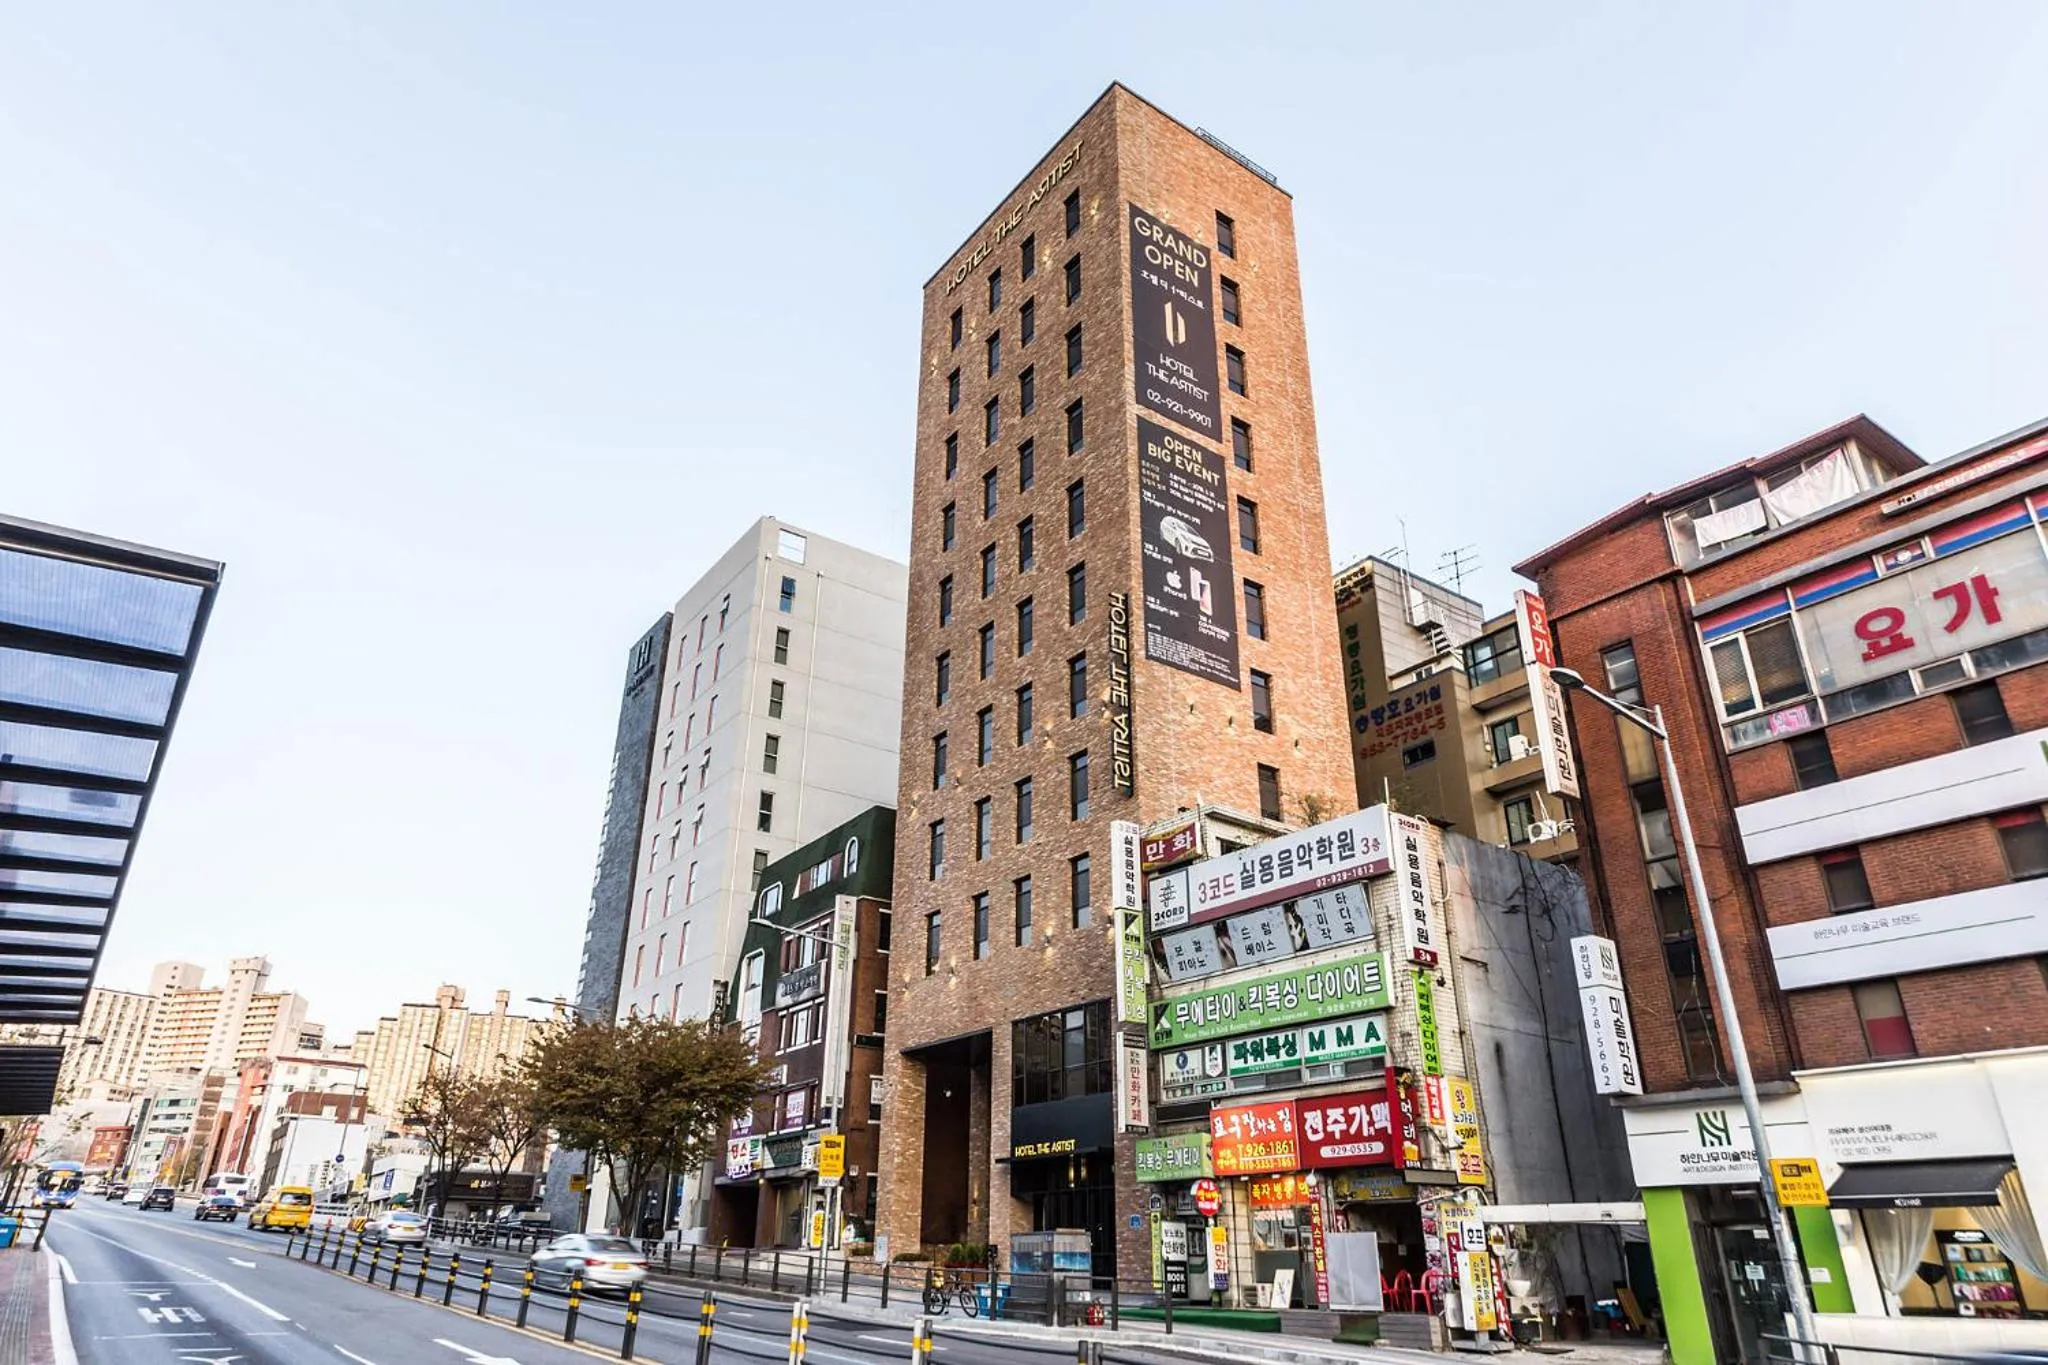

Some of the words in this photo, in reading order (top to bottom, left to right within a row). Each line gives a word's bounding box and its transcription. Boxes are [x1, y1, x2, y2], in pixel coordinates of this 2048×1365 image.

[946, 241, 993, 297] HOTEL
[994, 203, 1025, 244] THE
[1027, 139, 1085, 212] ARTIST
[1134, 216, 1207, 268] GRAND
[1144, 245, 1198, 288] OPEN
[1145, 361, 1169, 383] THE
[1169, 376, 1209, 402] ARTIST
[1160, 353, 1198, 382] HOTEL
[1146, 388, 1212, 428] 02-921-9901
[1147, 442, 1172, 463] BIG
[1175, 454, 1220, 487] EVENT
[1164, 436, 1202, 464] OPEN
[1854, 574, 2003, 663] 요가
[1199, 873, 1236, 904] 3코드
[1239, 828, 1355, 891] 실용음악학원
[1405, 834, 1429, 945] 실용음악학원
[1178, 956, 1207, 972] 피아노
[1244, 939, 1277, 956] 베이스
[1154, 1028, 1173, 1041] GYM
[1234, 1033, 1297, 1064] 파워복싱
[1609, 996, 1636, 1086] 미술학원
[1015, 1145, 1037, 1158] HOTEL
[1330, 1143, 1374, 1156] 929-0535
